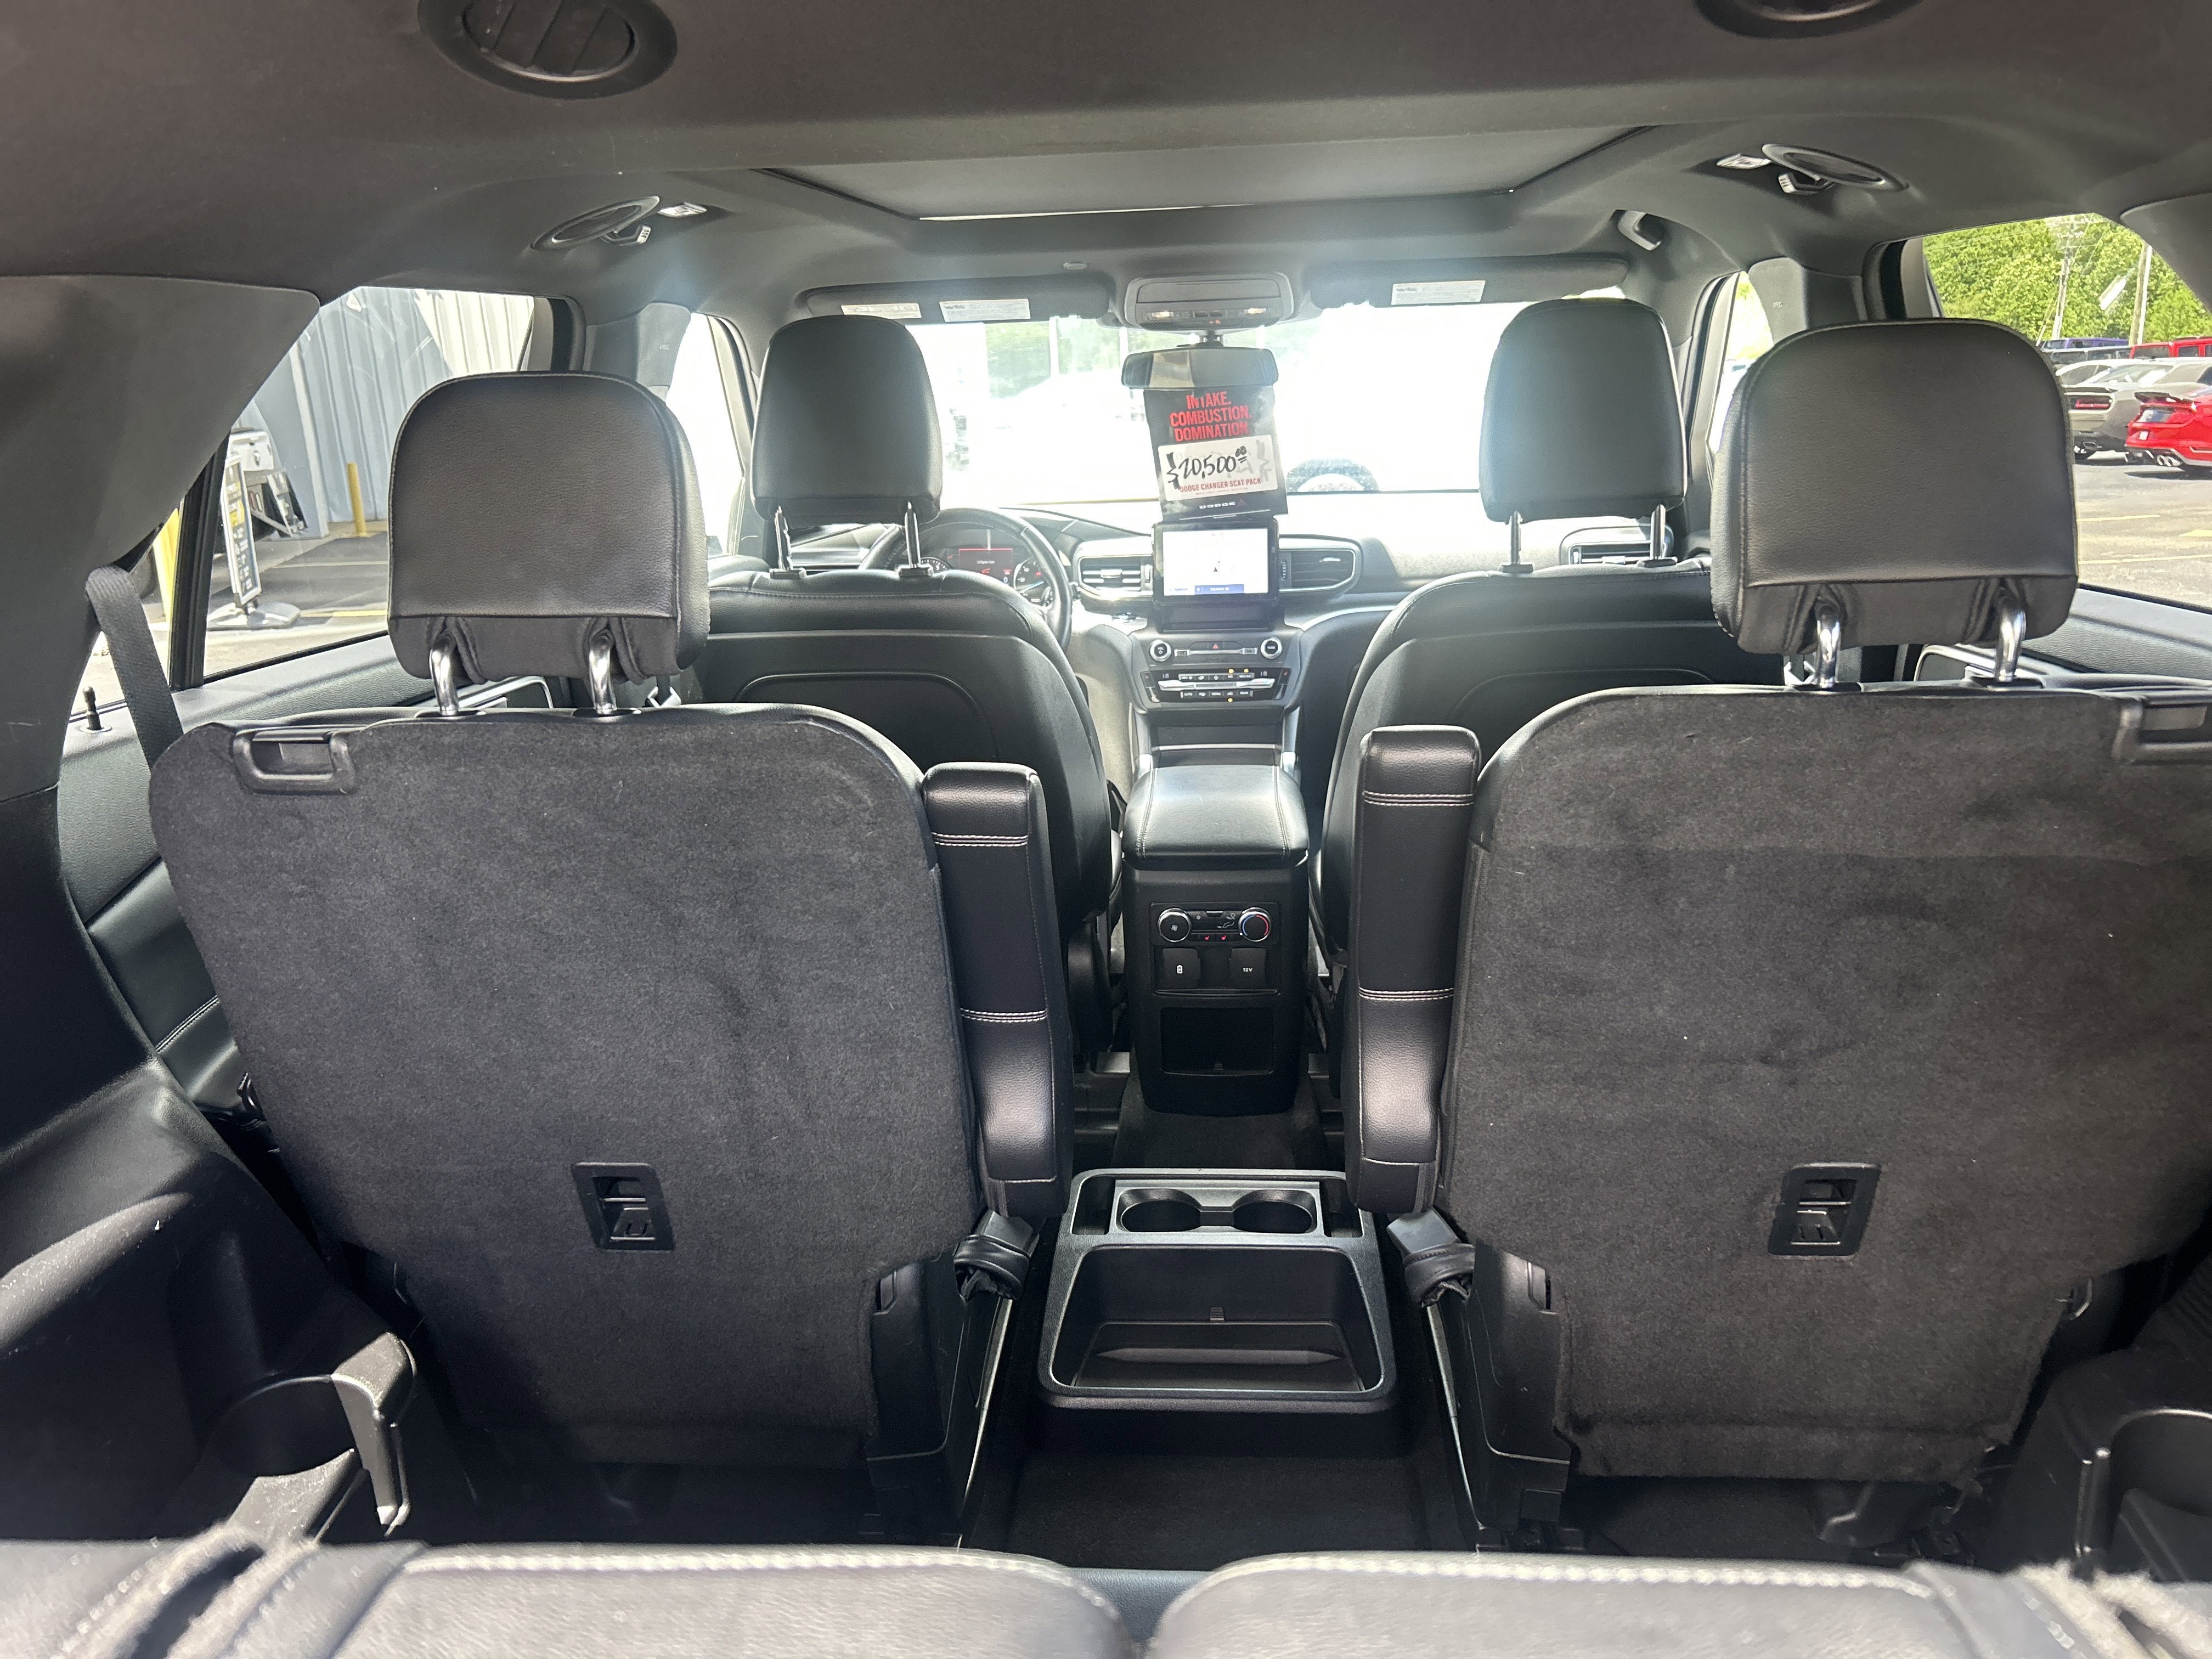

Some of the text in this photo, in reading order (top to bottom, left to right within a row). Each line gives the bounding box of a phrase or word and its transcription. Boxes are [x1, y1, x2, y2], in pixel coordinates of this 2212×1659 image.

[1186, 391, 1232, 409] INTAKE.
[1170, 405, 1252, 427] COMBUSTION.
[1174, 421, 1250, 442] DOMINATION.
[1180, 484, 1200, 493] DODGE
[1201, 481, 1228, 491] CHARGER
